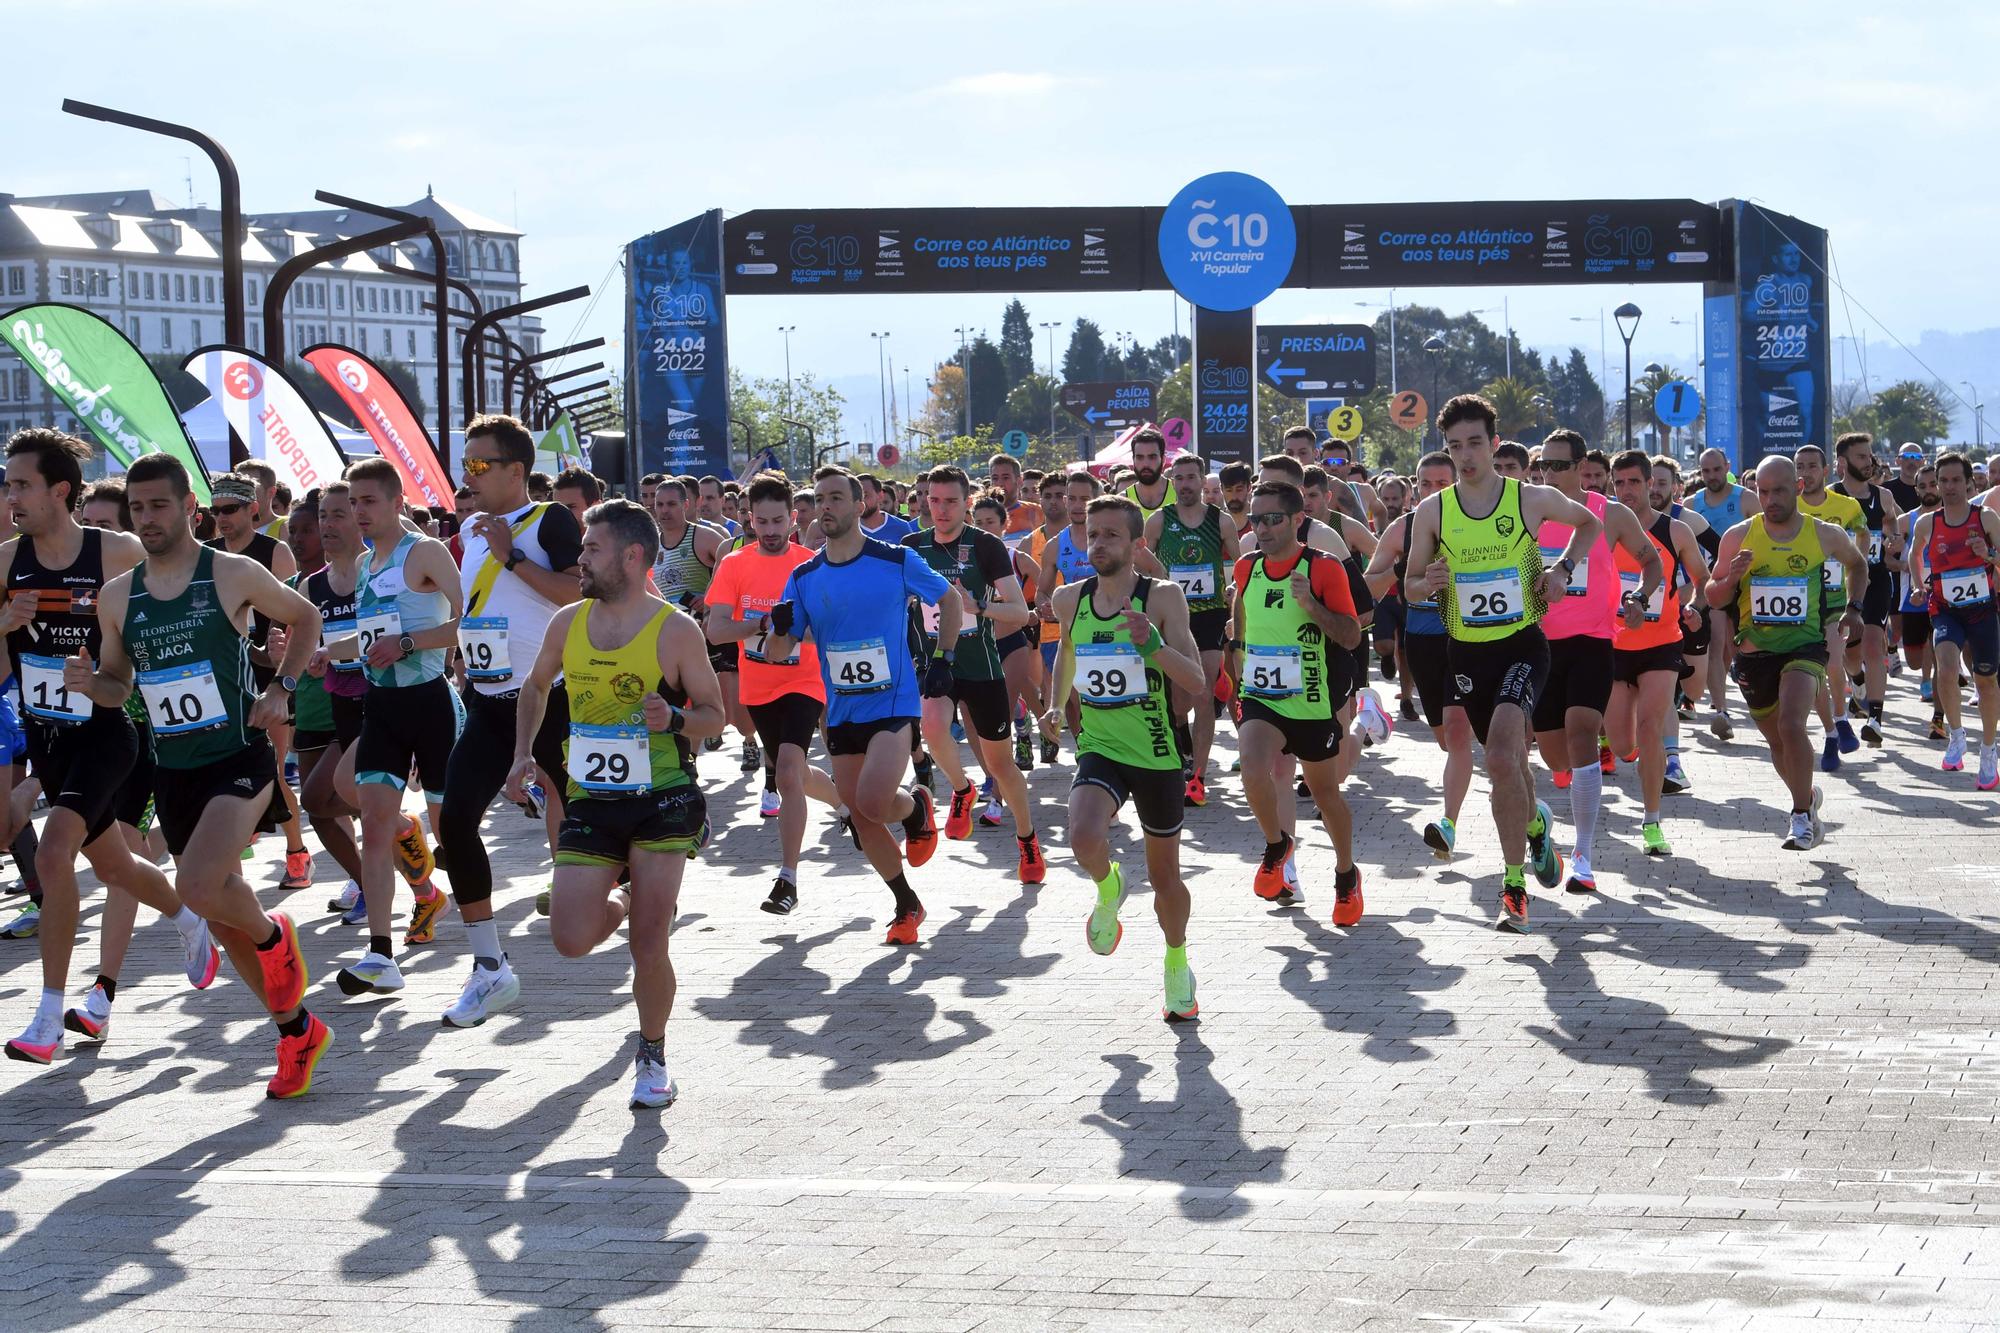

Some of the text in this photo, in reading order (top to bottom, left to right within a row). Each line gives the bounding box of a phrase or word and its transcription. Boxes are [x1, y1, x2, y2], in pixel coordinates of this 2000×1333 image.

[914, 235, 1070, 251] Corre co Atlántico
[1379, 229, 1534, 246] Corre co Atlántico
[937, 252, 1047, 272] aos teus pés
[1190, 250, 1264, 262] XVI Carreira
[1402, 245, 1510, 265] aos teus pés
[805, 267, 837, 276] Carreira
[1203, 263, 1251, 277] Popular
[792, 276, 820, 284] Popular
[1280, 333, 1366, 352] PRESAÍDA
[1756, 325, 1807, 341] 24.04
[653, 336, 706, 353] 24.04
[1759, 341, 1806, 359] 2022
[656, 353, 705, 372] 2022
[1115, 386, 1150, 398] SAÍDA
[1672, 385, 1684, 413] 1
[1107, 398, 1150, 409] PEQUES
[1203, 403, 1248, 417] 24.04
[1400, 394, 1418, 417] 2
[1205, 418, 1247, 433] 2022
[1337, 410, 1353, 431] 3
[556, 424, 570, 452] 1
[1168, 421, 1184, 440] 4
[1009, 433, 1022, 450] 5
[1461, 544, 1507, 556] RUNNING
[1461, 556, 1479, 564] LUGO
[1179, 579, 1203, 594] 74
[1952, 583, 1979, 602] 24
[1470, 592, 1508, 617] 26
[1755, 596, 1802, 616] 108
[50, 627, 91, 637] VICKY
[140, 618, 204, 638] FLORISTERIA
[152, 631, 195, 647] EL CISNE
[157, 643, 193, 660] JACA
[466, 642, 492, 670] 19
[840, 661, 875, 684] 48
[1254, 666, 1287, 689] 51
[1302, 651, 1320, 702] O PINO
[1500, 662, 1521, 696] RUNNING
[1510, 663, 1532, 699] LUGO CLUB
[1087, 669, 1126, 697] 39
[33, 682, 73, 713] 11
[159, 693, 203, 726] 10
[1144, 717, 1170, 757] PINO
[585, 753, 630, 783] 29
